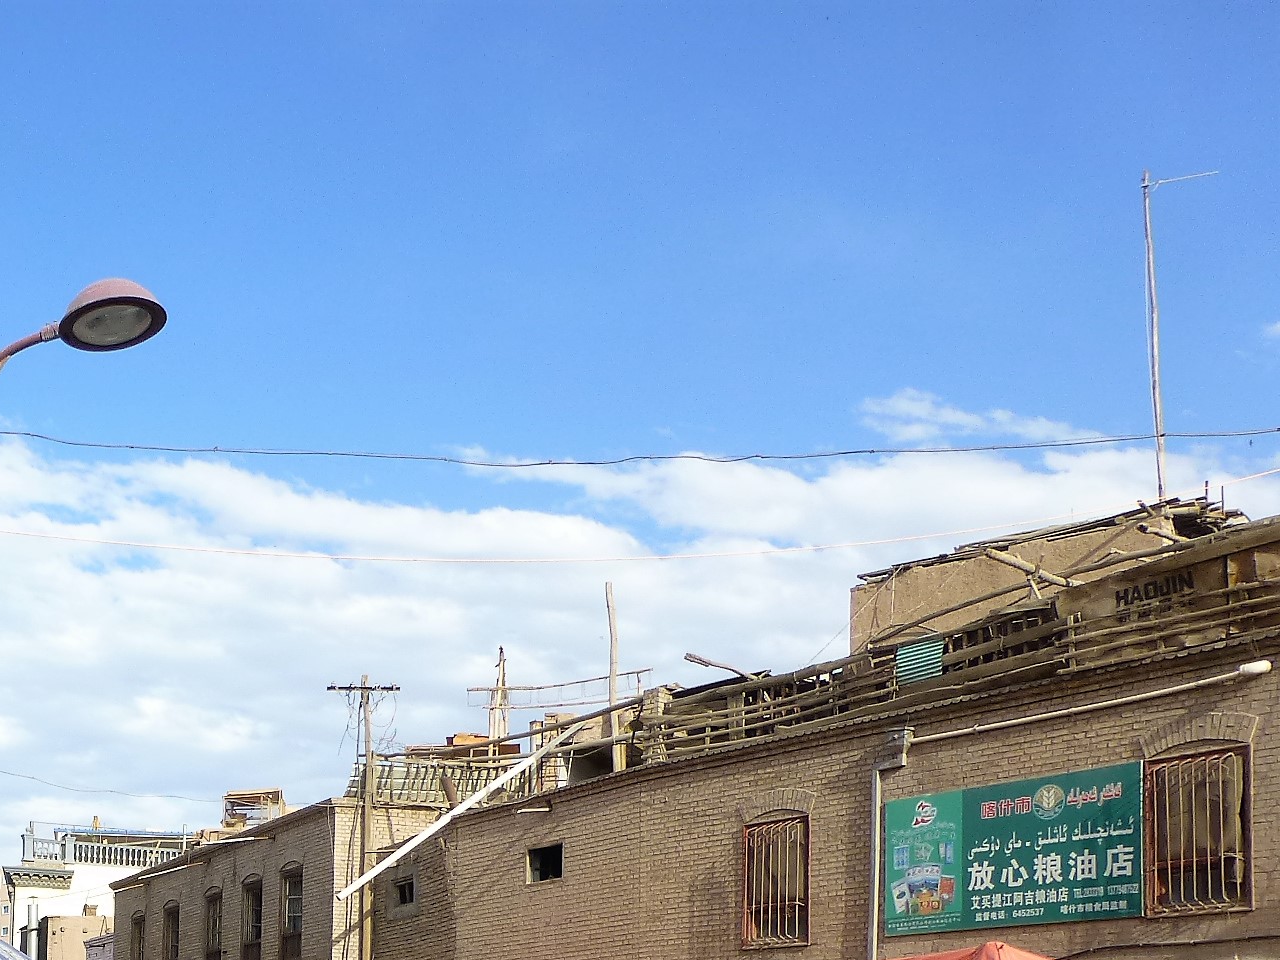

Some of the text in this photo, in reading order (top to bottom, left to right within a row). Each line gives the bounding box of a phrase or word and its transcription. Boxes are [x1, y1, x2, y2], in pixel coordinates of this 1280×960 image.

[981, 796, 1032, 820] 喀什市
[967, 844, 1135, 891] 放心粮油店
